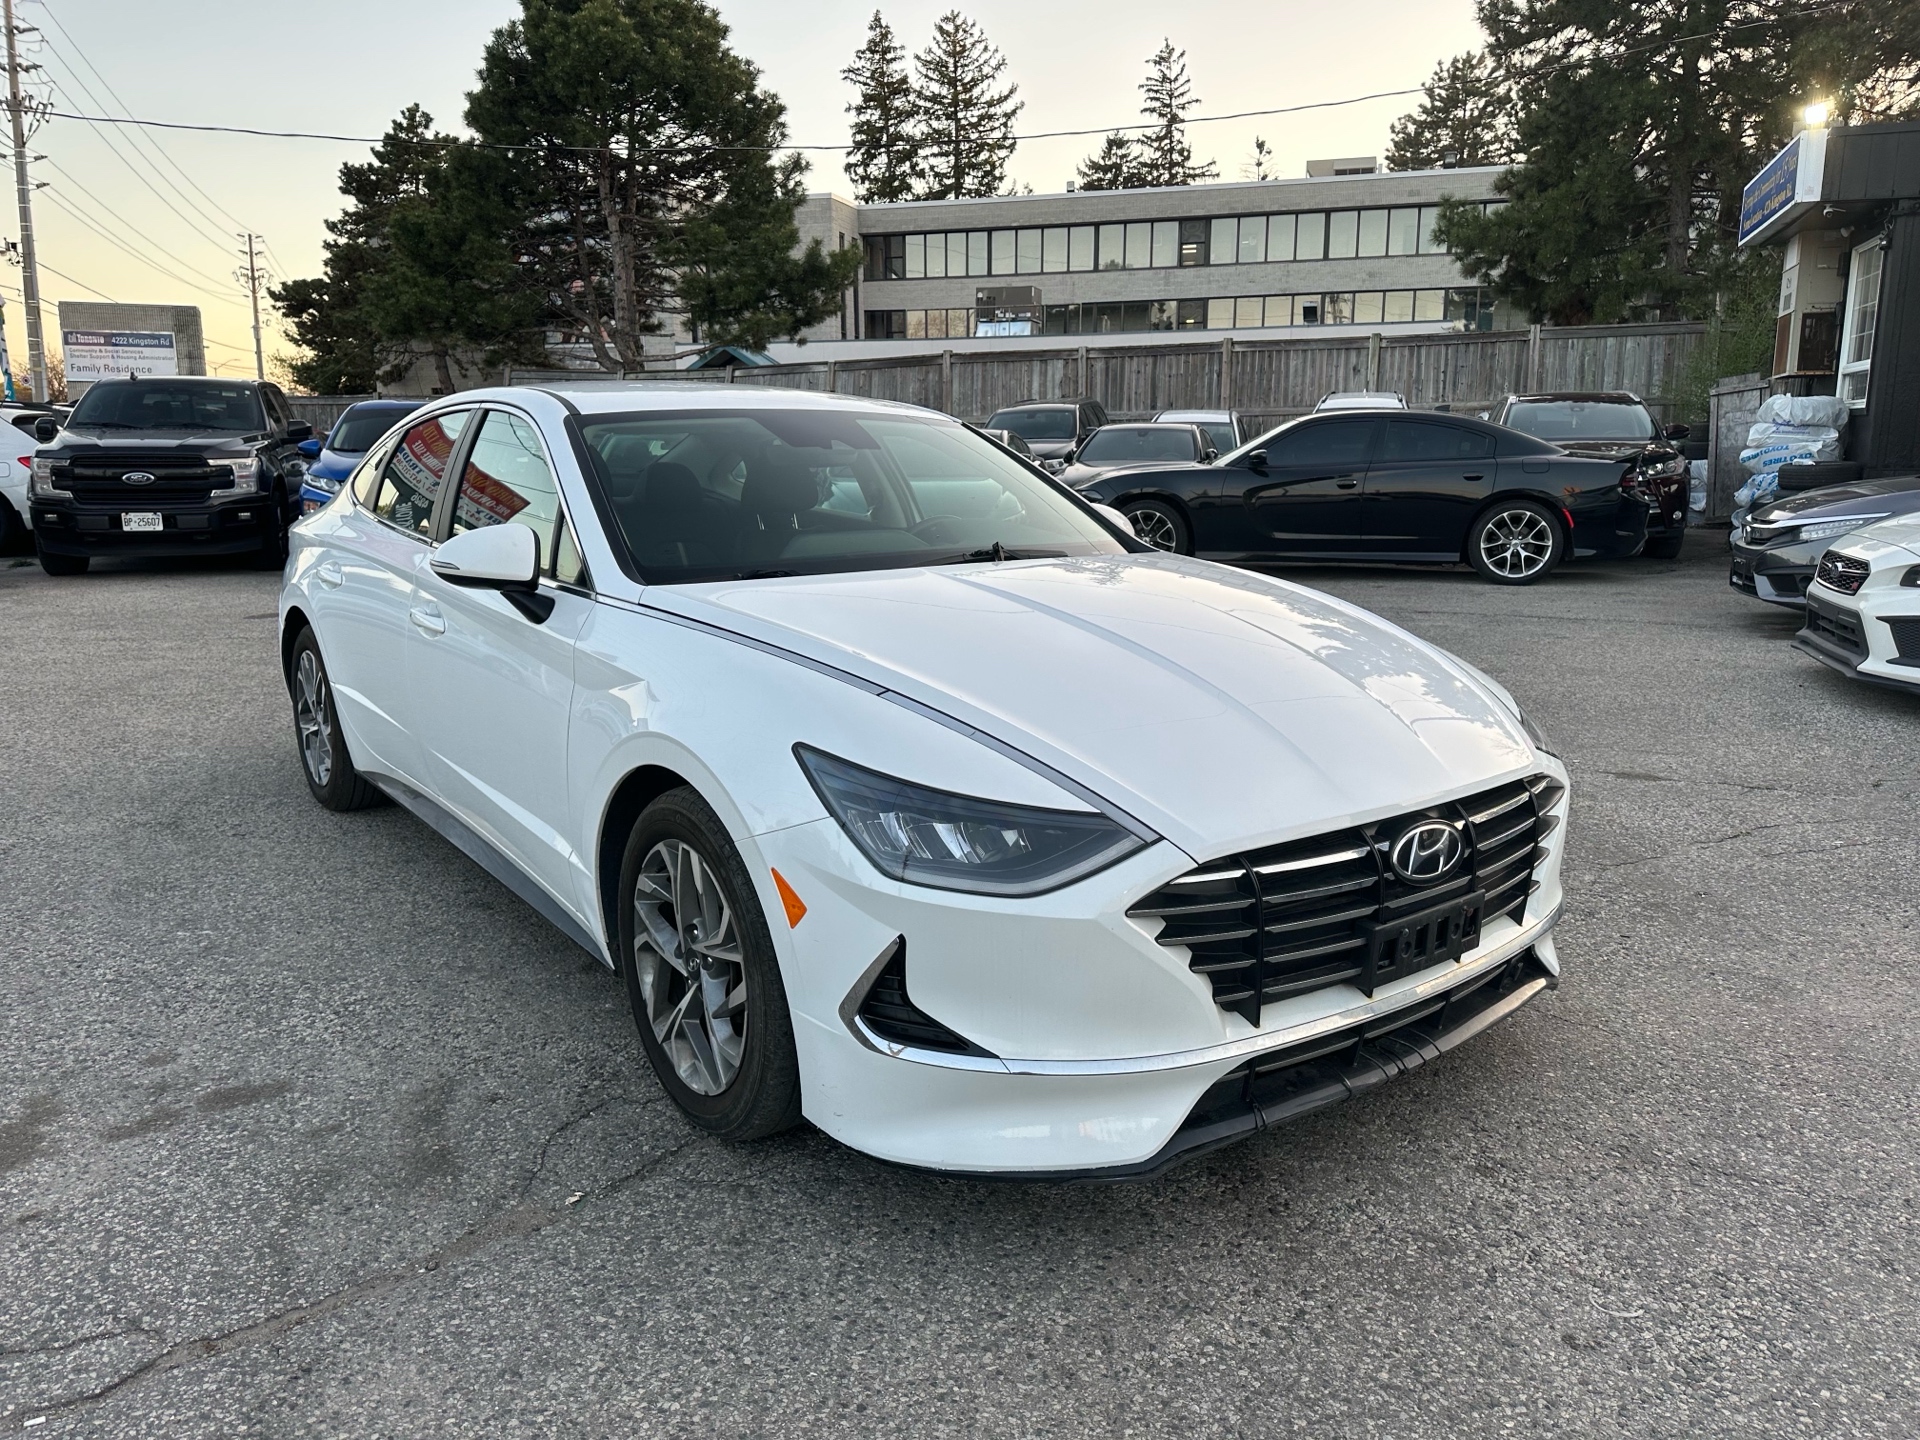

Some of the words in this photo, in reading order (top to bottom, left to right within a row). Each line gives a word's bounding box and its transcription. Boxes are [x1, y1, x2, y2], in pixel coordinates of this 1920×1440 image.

[111, 336, 128, 345] 4222
[129, 336, 158, 347] Kingston
[160, 338, 170, 346] Rd
[68, 347, 98, 355] Community
[89, 353, 110, 361] Support
[70, 363, 101, 375] Family
[104, 364, 152, 374] Residence
[1762, 455, 1789, 467] TIRES
[137, 518, 160, 527] 25607
